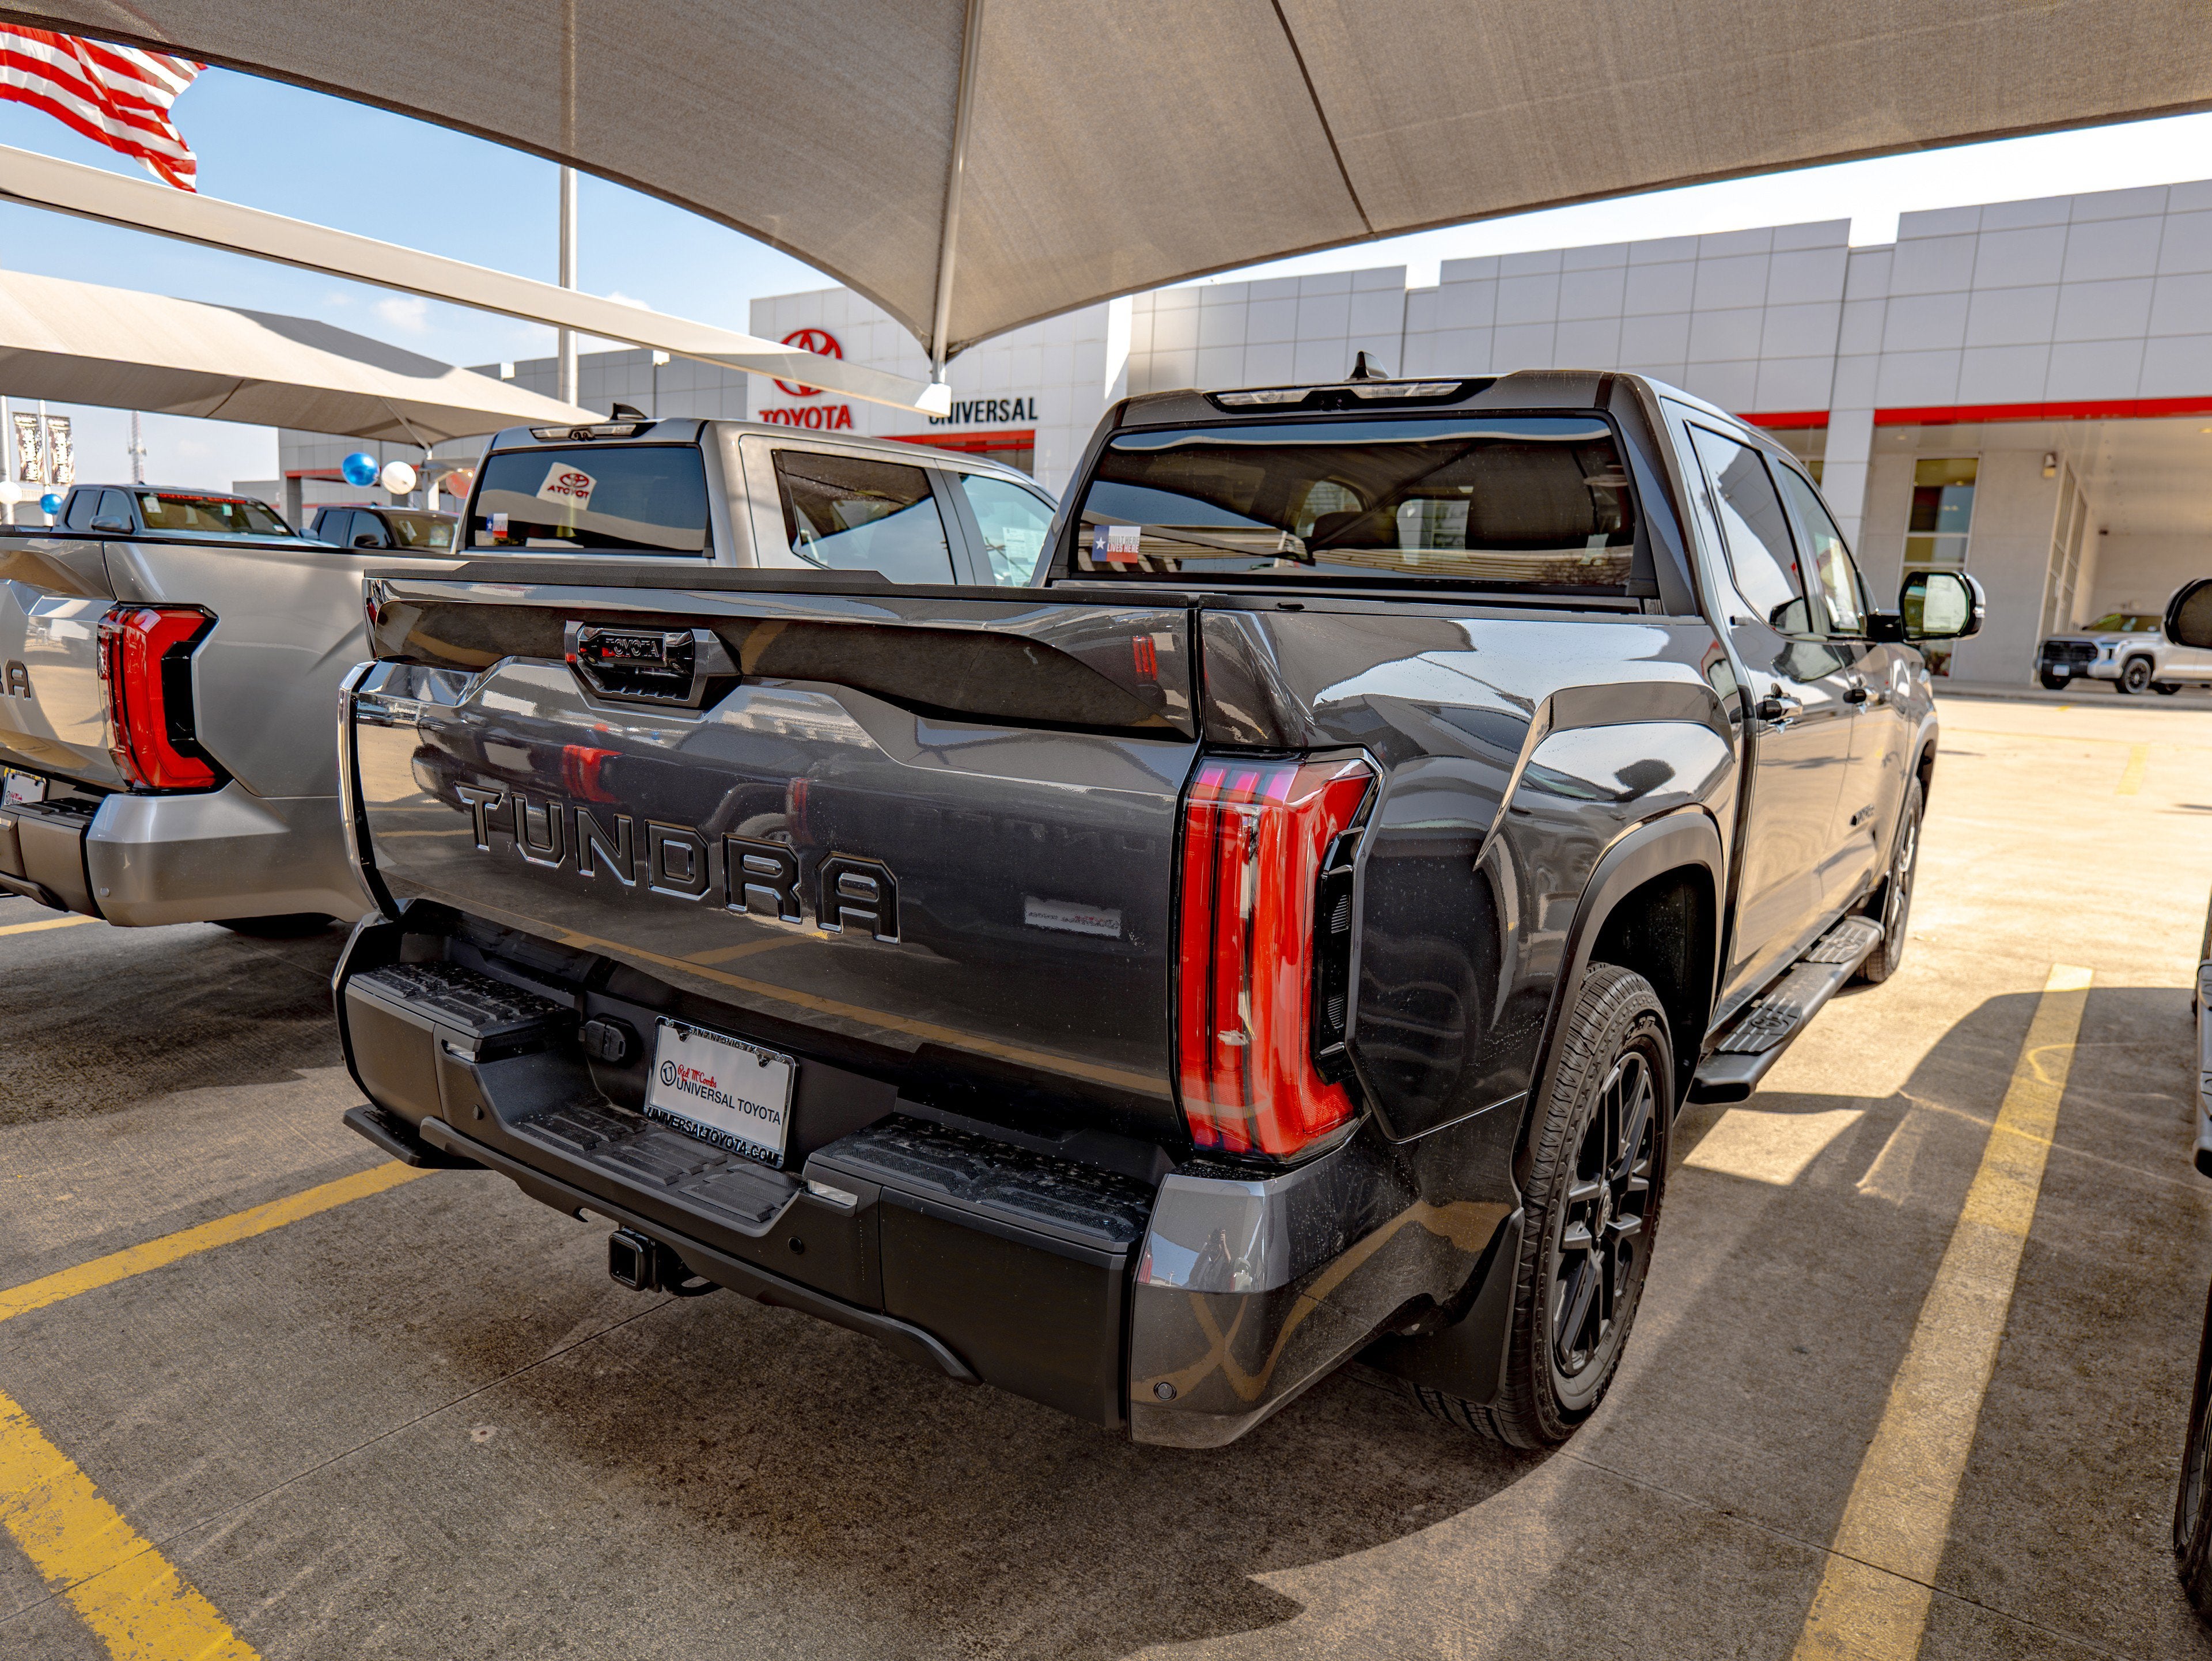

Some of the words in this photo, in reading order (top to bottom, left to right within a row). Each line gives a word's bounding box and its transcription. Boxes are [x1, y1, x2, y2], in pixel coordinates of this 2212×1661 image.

[759, 404, 854, 429] TOYOTA
[1107, 543, 1123, 552] LIVES
[1124, 544, 1139, 553] HERE
[1108, 535, 1124, 544] BUILT
[1125, 536, 1140, 545] HERE
[605, 638, 659, 657] TOYOTA
[0, 659, 31, 701] A
[454, 781, 900, 945] TUNDRA
[678, 1064, 690, 1082] Red
[691, 1068, 717, 1088] McCombs
[676, 1077, 735, 1109] UNIVERSAL
[737, 1098, 781, 1125] TOYOTA
[646, 1107, 781, 1167] UNIVERSALTOYOTA.COM
